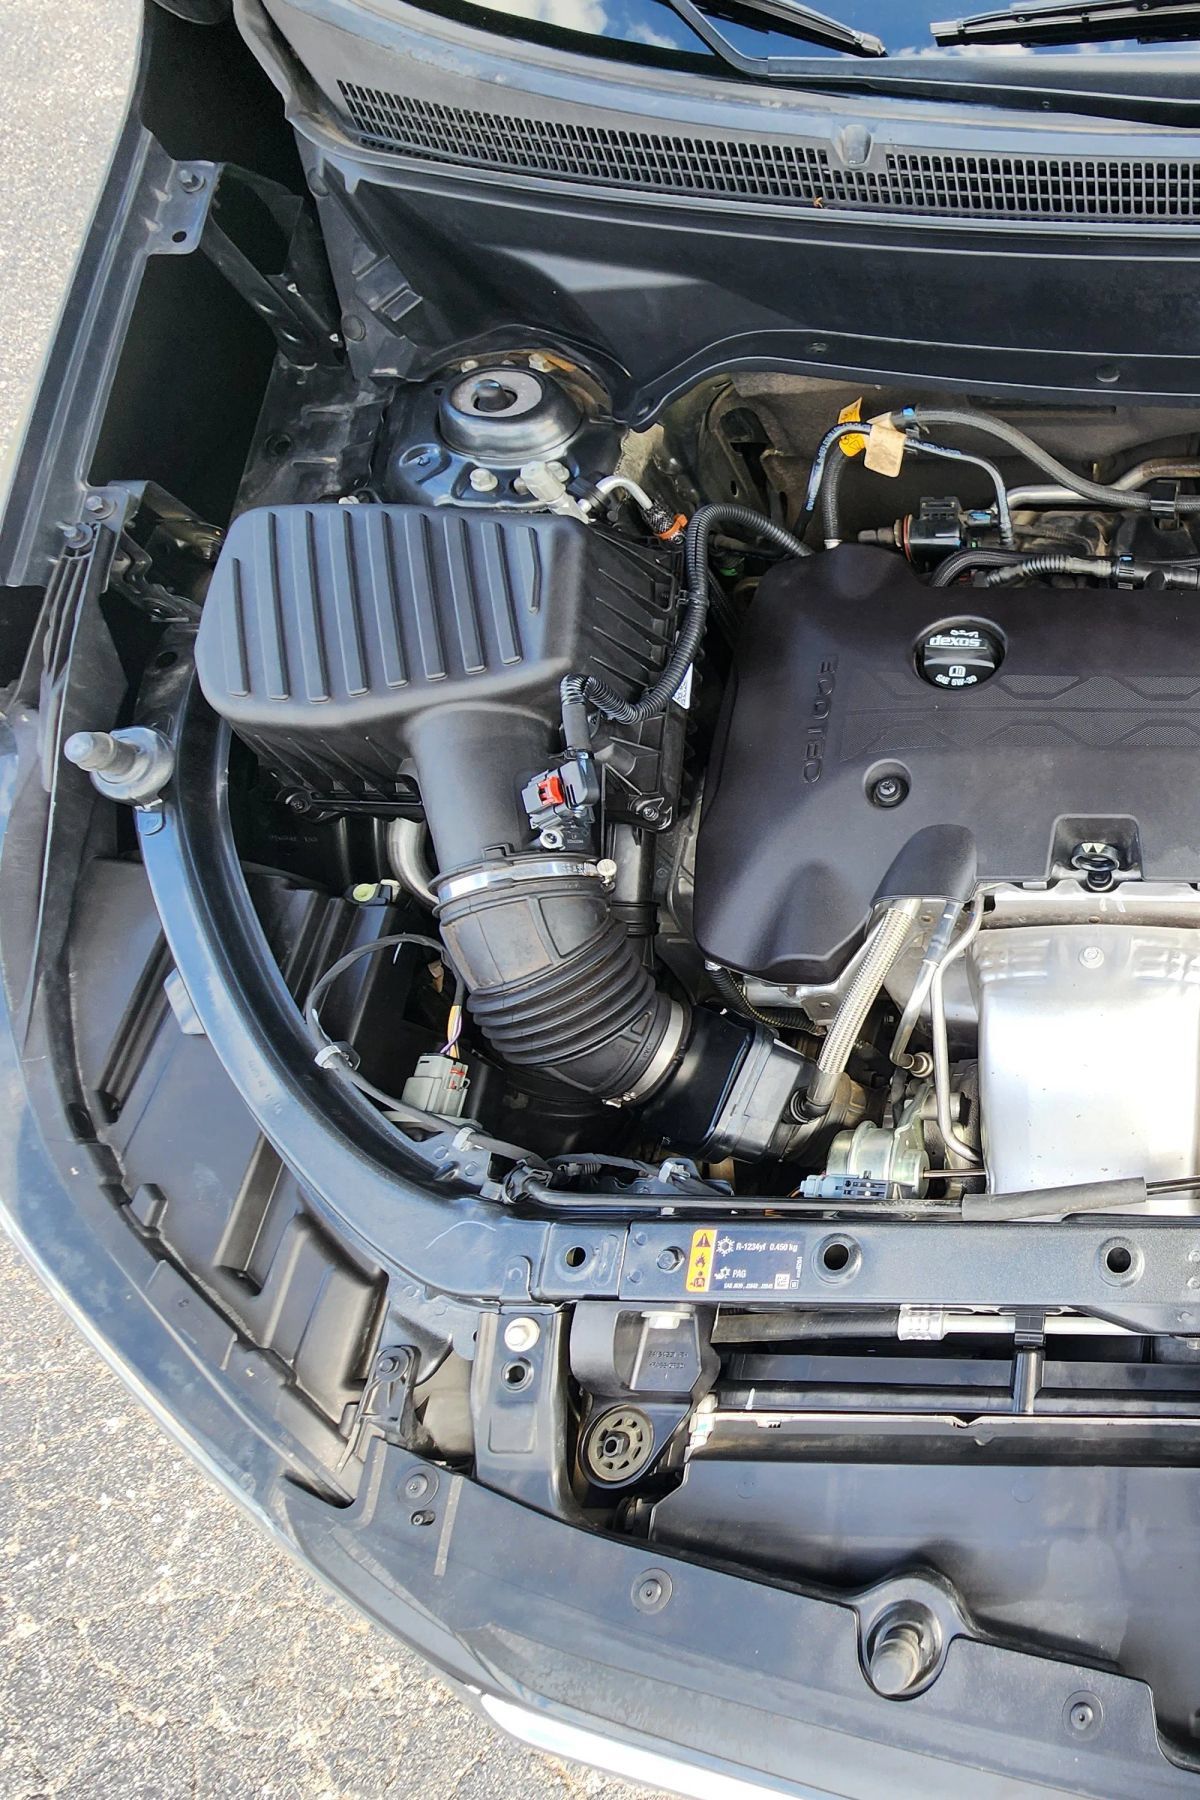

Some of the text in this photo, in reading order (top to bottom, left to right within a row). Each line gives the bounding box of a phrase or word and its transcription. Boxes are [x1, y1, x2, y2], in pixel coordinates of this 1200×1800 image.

[929, 635, 981, 647] dexos
[935, 674, 950, 685] SAE
[802, 653, 838, 783] ECOTEC
[788, 1243, 799, 1253] kg
[732, 1269, 747, 1278] PAG
